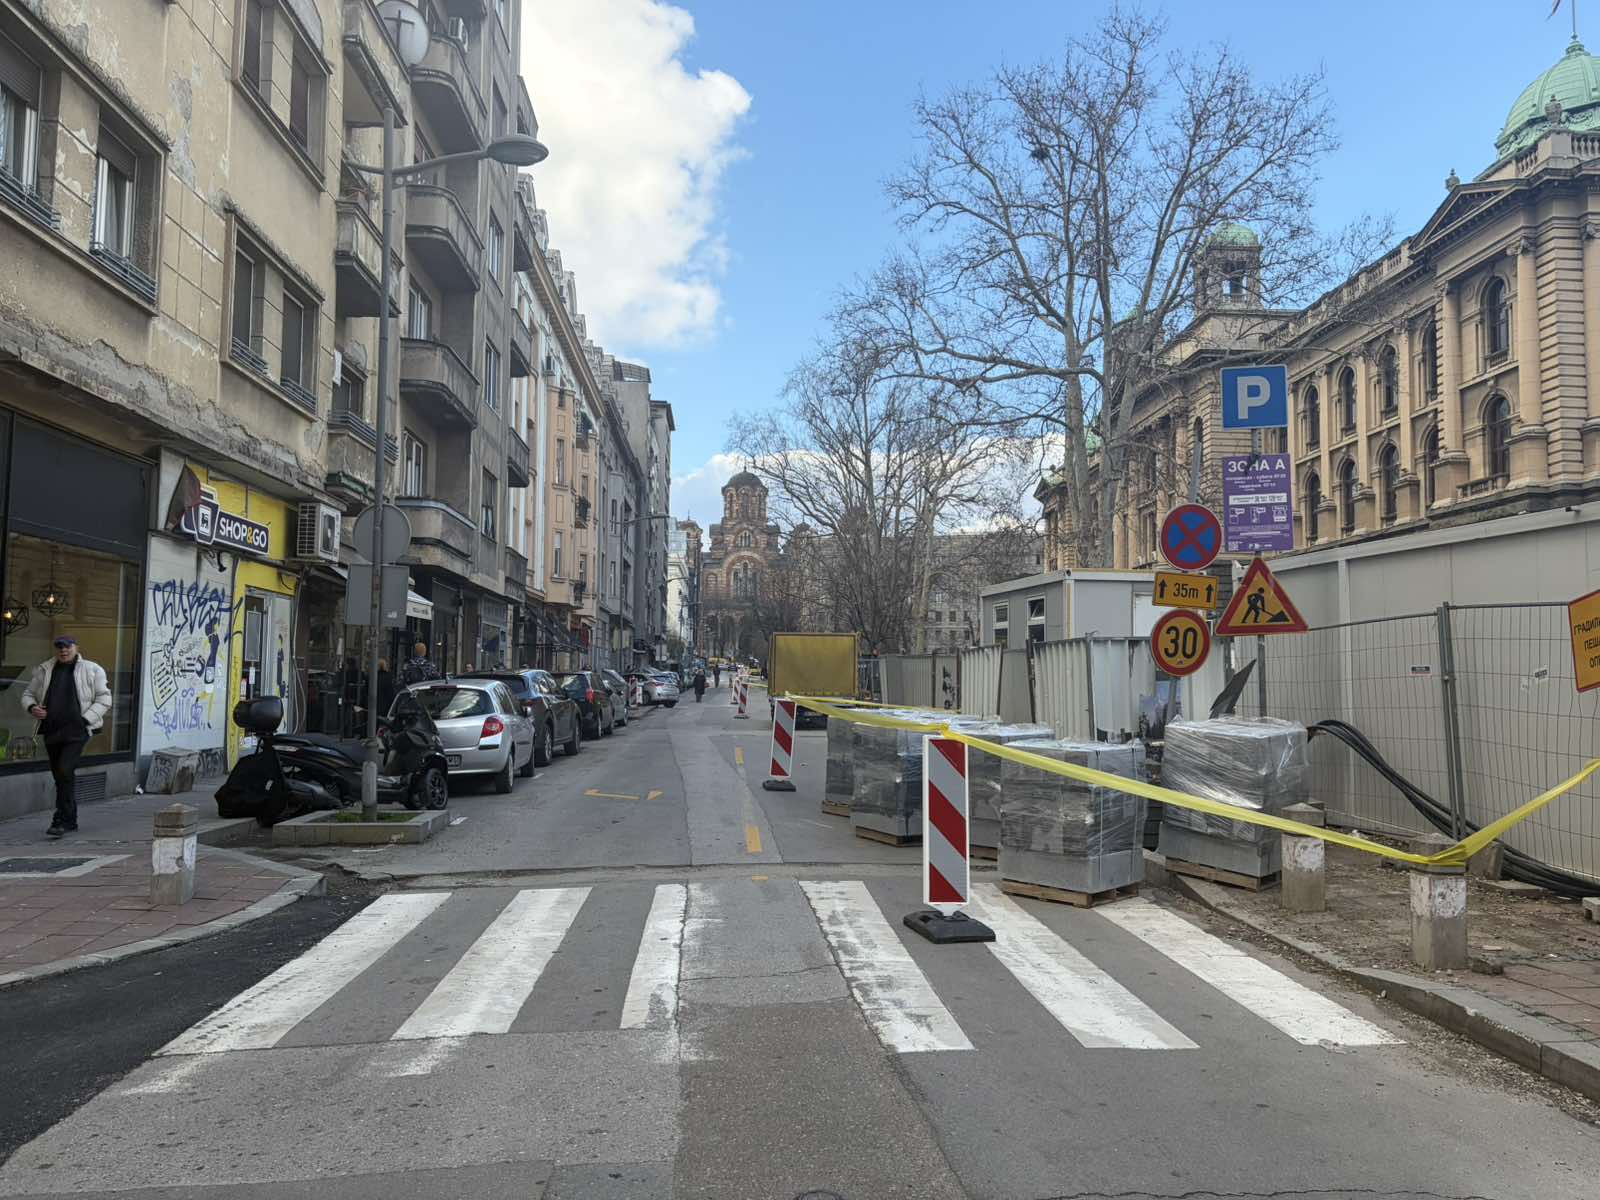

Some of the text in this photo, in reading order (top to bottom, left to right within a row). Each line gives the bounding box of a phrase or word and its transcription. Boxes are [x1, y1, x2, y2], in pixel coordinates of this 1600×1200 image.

[1237, 376, 1270, 419] P
[219, 517, 267, 548] SHOP&GO
[1173, 582, 1199, 599] 35m
[1573, 616, 1600, 636] ГРАДИЛ
[1164, 626, 1198, 659] 30
[1584, 636, 1600, 652] ПЕШ
